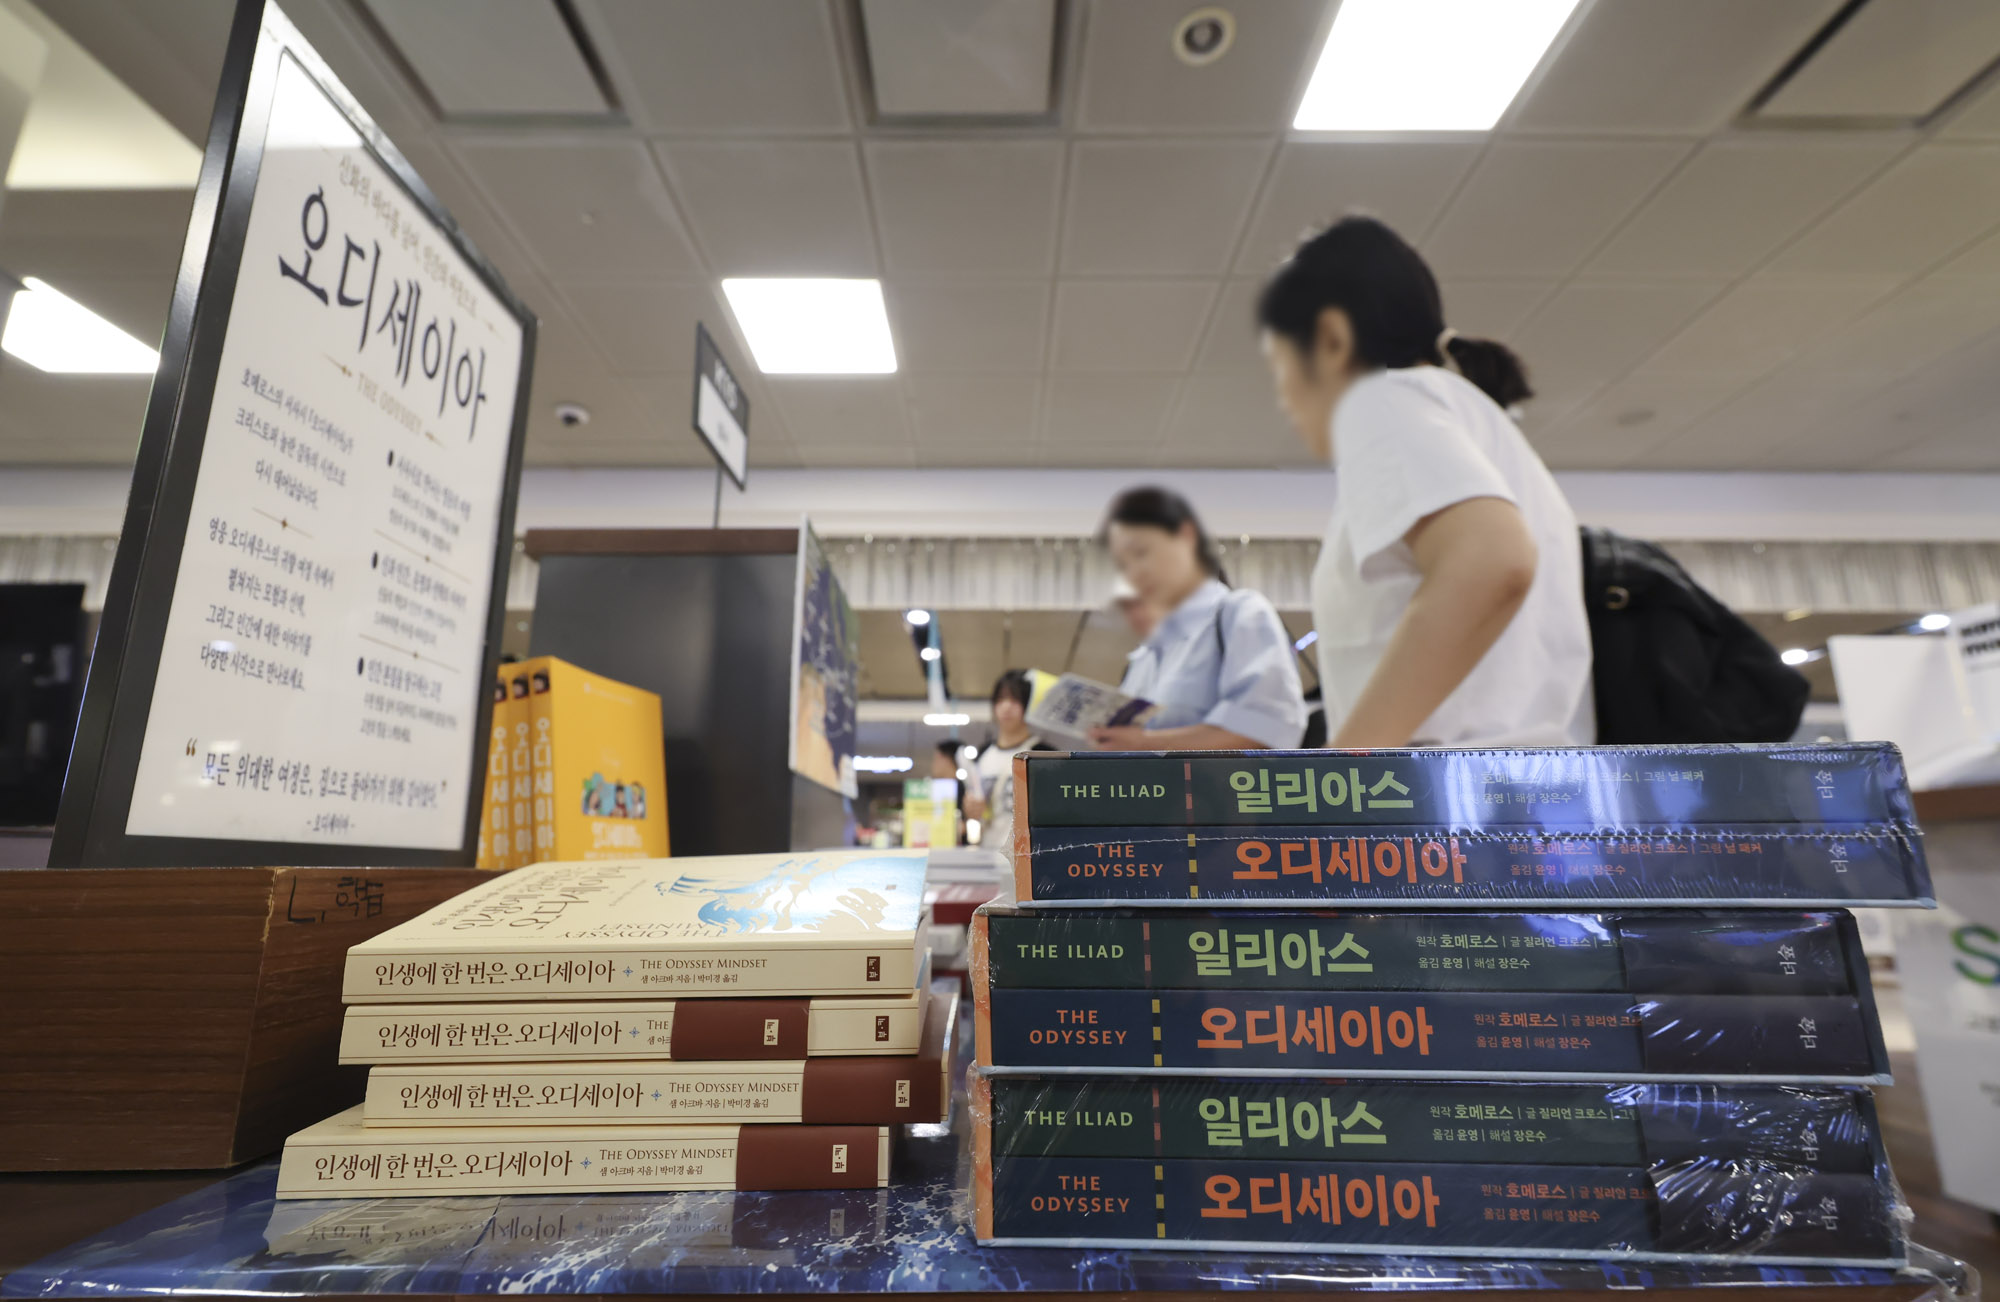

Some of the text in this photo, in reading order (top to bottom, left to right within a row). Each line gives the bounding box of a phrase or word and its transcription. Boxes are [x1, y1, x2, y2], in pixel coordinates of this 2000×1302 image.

[278, 186, 487, 442] 오디세이아
[210, 517, 280, 566] 영웅 오디세우스의
[206, 604, 235, 629] 그리고
[200, 643, 228, 672] 다양한
[230, 651, 264, 679] 시각으로
[202, 753, 231, 786] 모든
[235, 753, 273, 791] 위대한
[319, 766, 347, 797] 집으로
[533, 717, 554, 848] 오디세이아
[1644, 771, 1665, 782] 그림
[1668, 771, 1680, 782] 닐
[1682, 771, 1704, 782] 패커
[513, 722, 532, 852] 오디세이아
[1060, 784, 1166, 798] THE ILIAD
[1229, 767, 1414, 814] 일리아스
[1815, 769, 1835, 800] 더숲
[1515, 793, 1536, 804] 해설
[1540, 792, 1572, 804] 장은수
[1094, 844, 1136, 859] THE
[1532, 841, 1592, 855] 호메로스
[1655, 843, 1688, 854] 크로스
[1232, 836, 1467, 885] 오디세이아
[1828, 842, 1849, 874] 더숲
[1067, 862, 1164, 878] ODYSSEY
[1535, 864, 1556, 876] 윤영
[1592, 864, 1626, 876] 장은수
[564, 930, 669, 938] ODYSSEY
[1416, 934, 1591, 949] 원작 호메로스 글 질리언 크로스
[1018, 944, 1125, 960] THE ILIAD
[1188, 928, 1374, 977] 일리아스
[1778, 944, 1797, 976] 더숲
[640, 958, 768, 969] THE ODYSSEY MINDSET
[1418, 958, 1531, 969] 옮김 윤영 해설 장은수
[376, 960, 616, 986] 인생에 한 번은 오디세이아
[641, 974, 738, 984] 샘 아크바 지음 박미경 옮김
[1056, 1009, 1099, 1024] THE
[1474, 1012, 1617, 1028] 원작 호메로스 글 질리언
[647, 1020, 668, 1030] THE
[1196, 1005, 1434, 1056] 오디세이아
[1798, 1016, 1818, 1050] 더숲
[378, 1020, 622, 1049] 인생에 한 번은 오디세이아
[1029, 1029, 1128, 1045] ODYSSEY
[1476, 1036, 1591, 1048] 옮김 윤영 해설 장은수
[669, 1082, 800, 1093] THE ODYSSEY MINDSET
[400, 1083, 644, 1110] 인생에 한 번은 오디세이아
[670, 1098, 769, 1108] 샘 아크바 지음 박미경 옮김
[1025, 1110, 1134, 1127] THE ILIAD
[1430, 1104, 1608, 1120] 원작 호메로스 글 질리언 크로스
[1198, 1096, 1388, 1148] 일리아스
[1432, 1129, 1548, 1142] 옮김 윤영 해설 장은수
[600, 1148, 734, 1160] THE ODYSSEY MINDSET
[314, 1150, 574, 1181] 인생에 한 번은 오디세이아
[600, 1165, 703, 1176] 샘 아크바 지음 박미경 옮김
[1058, 1175, 1102, 1191] THE
[1506, 1183, 1568, 1200] 호메로스
[1030, 1196, 1130, 1212] ODYSSEY
[1200, 1172, 1440, 1228] 오디세이아
[1508, 1208, 1530, 1221] 윤영
[1568, 1210, 1600, 1222] 장은수
[1820, 1196, 1840, 1231] 더숲
